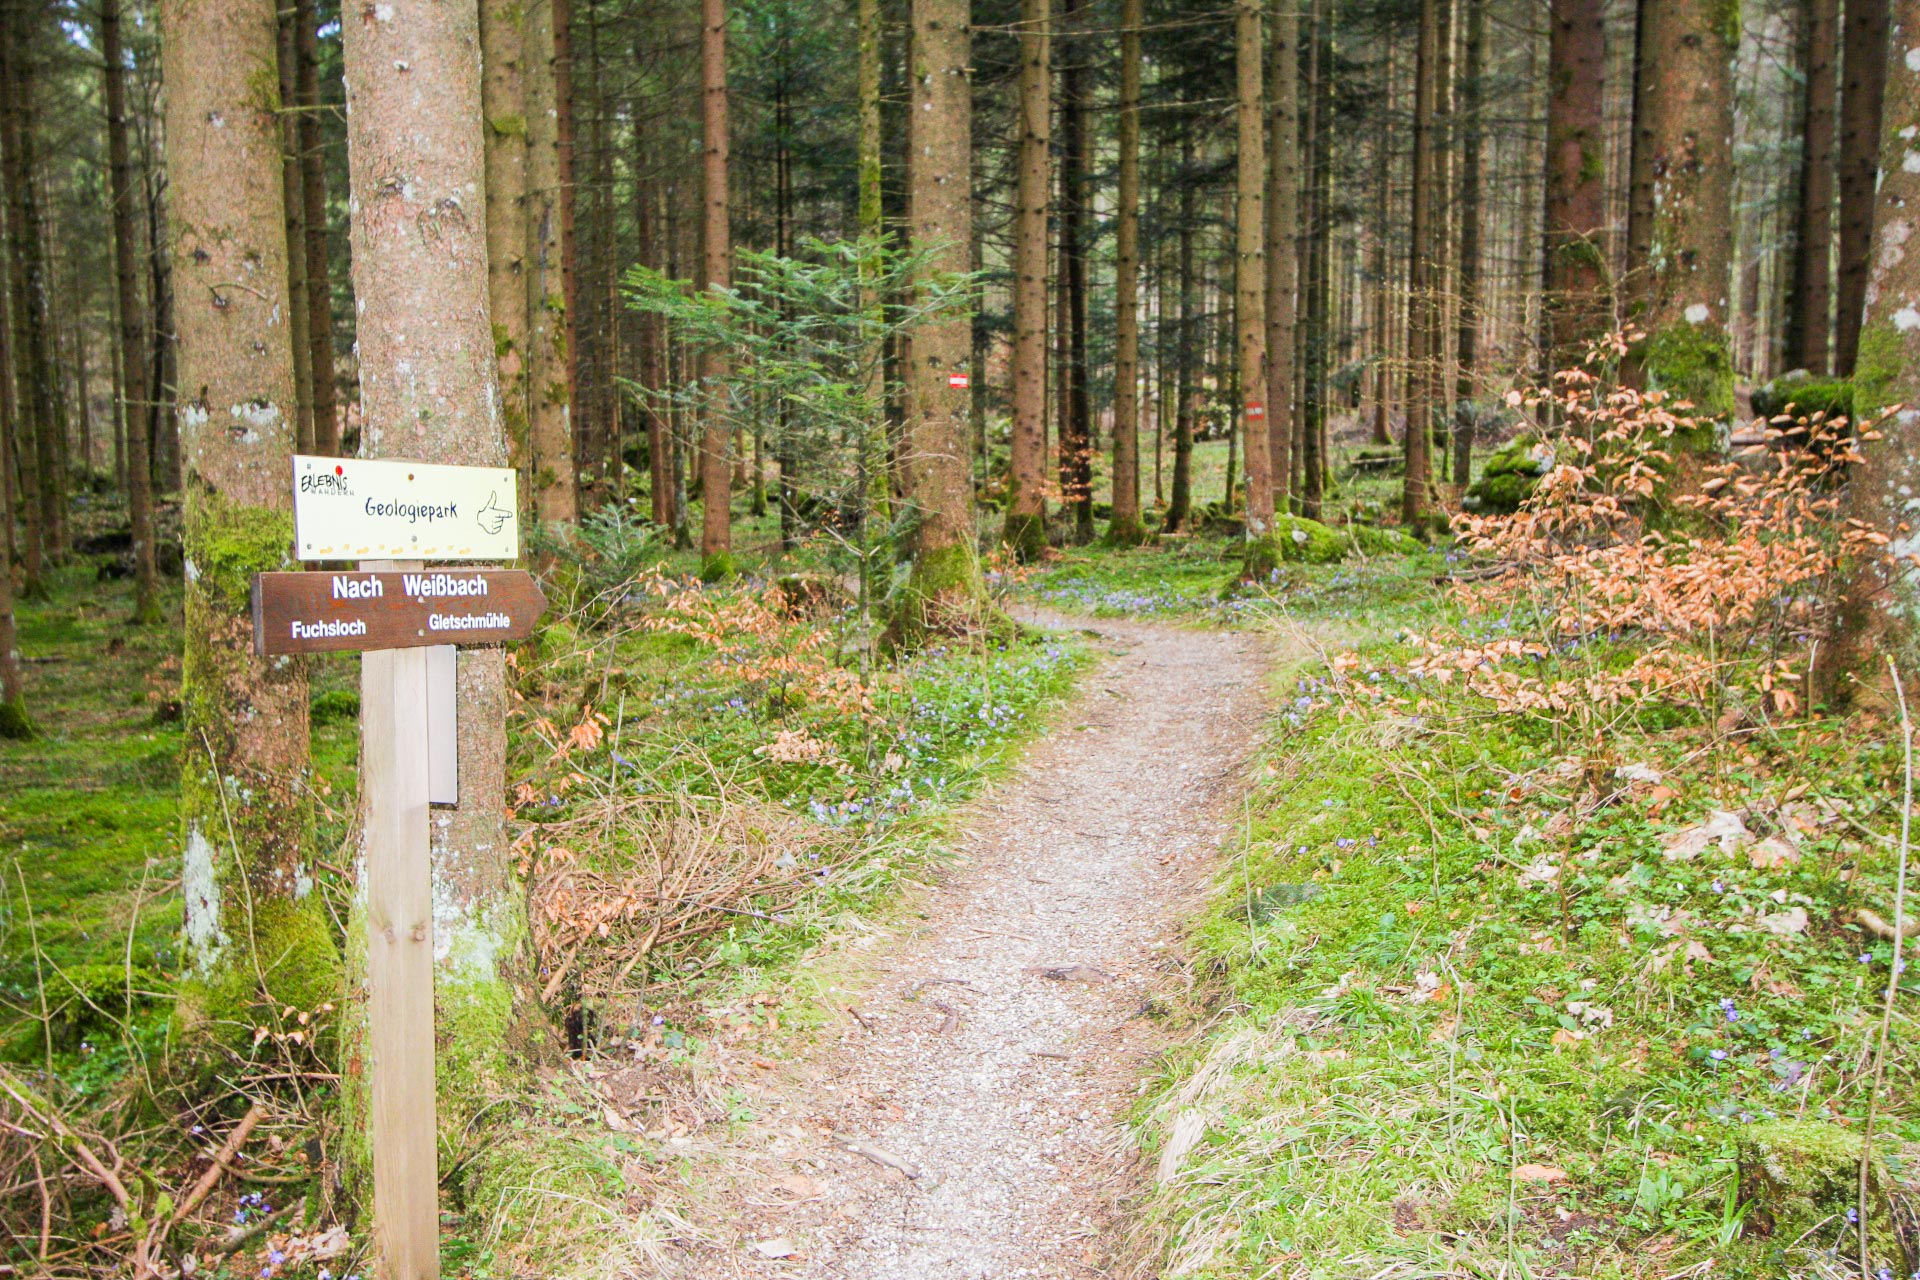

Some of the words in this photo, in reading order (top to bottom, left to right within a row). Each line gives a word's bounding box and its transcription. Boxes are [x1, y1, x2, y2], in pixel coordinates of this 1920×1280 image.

[301, 473, 348, 493] ERLEBNIS
[365, 496, 458, 523] Geologiepark
[332, 575, 383, 599] Nach
[402, 574, 488, 597] Weißbach
[291, 619, 366, 639] Fuchsloch
[429, 613, 511, 631] Gletschmühle
